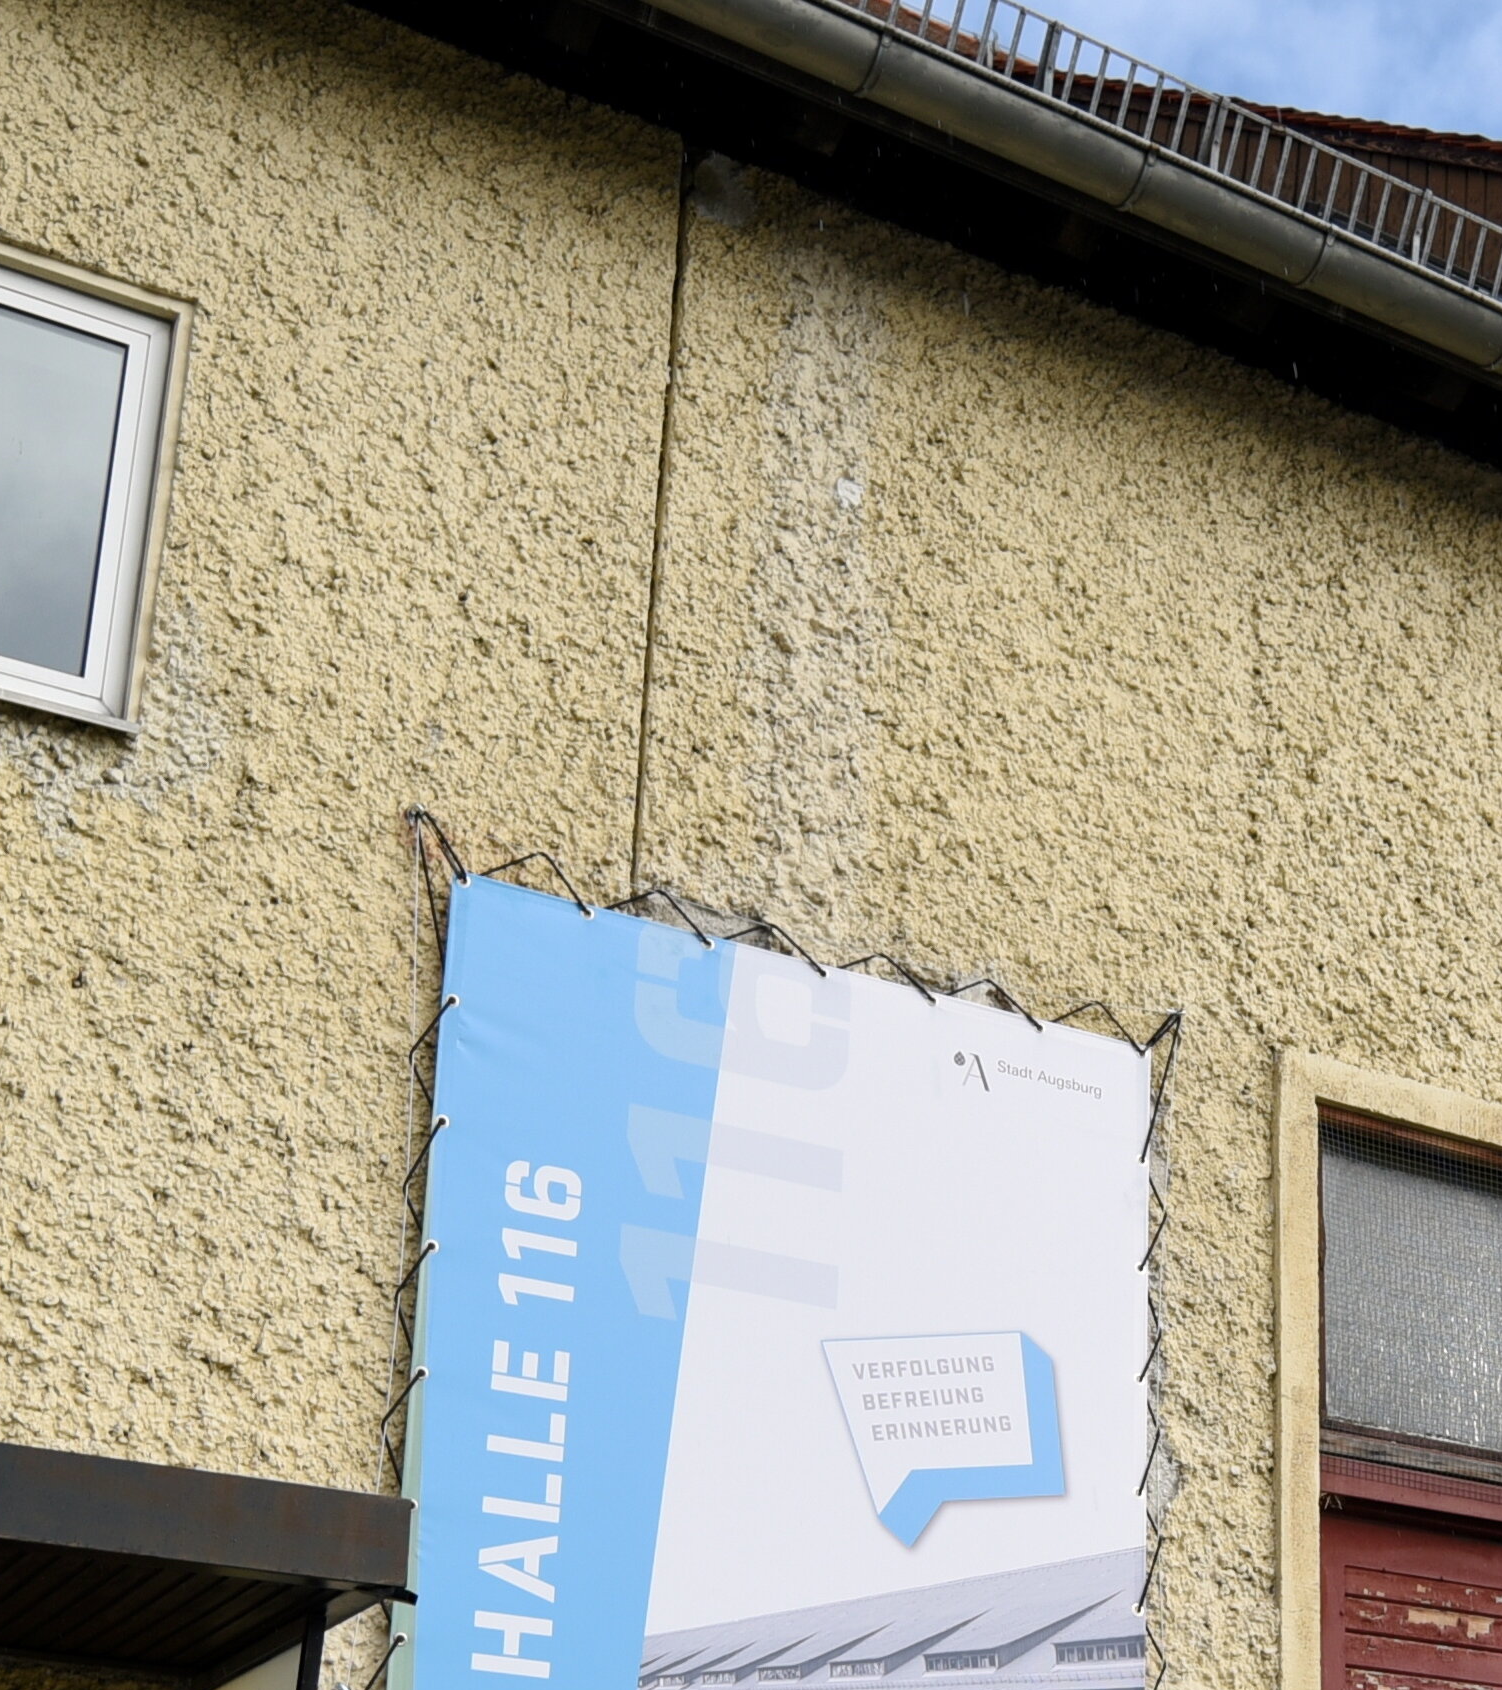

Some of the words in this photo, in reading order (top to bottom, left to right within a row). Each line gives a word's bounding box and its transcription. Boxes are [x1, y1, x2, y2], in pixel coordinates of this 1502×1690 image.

[997, 1060, 1033, 1080] Stadt
[1037, 1070, 1102, 1099] Augsburg
[498, 1159, 582, 1306] 116
[852, 1356, 994, 1380] VERFOLGUNG
[862, 1387, 984, 1411] BEFREIUNG
[871, 1415, 1012, 1441] ERINNERUNG
[471, 1339, 570, 1679] HALLE
